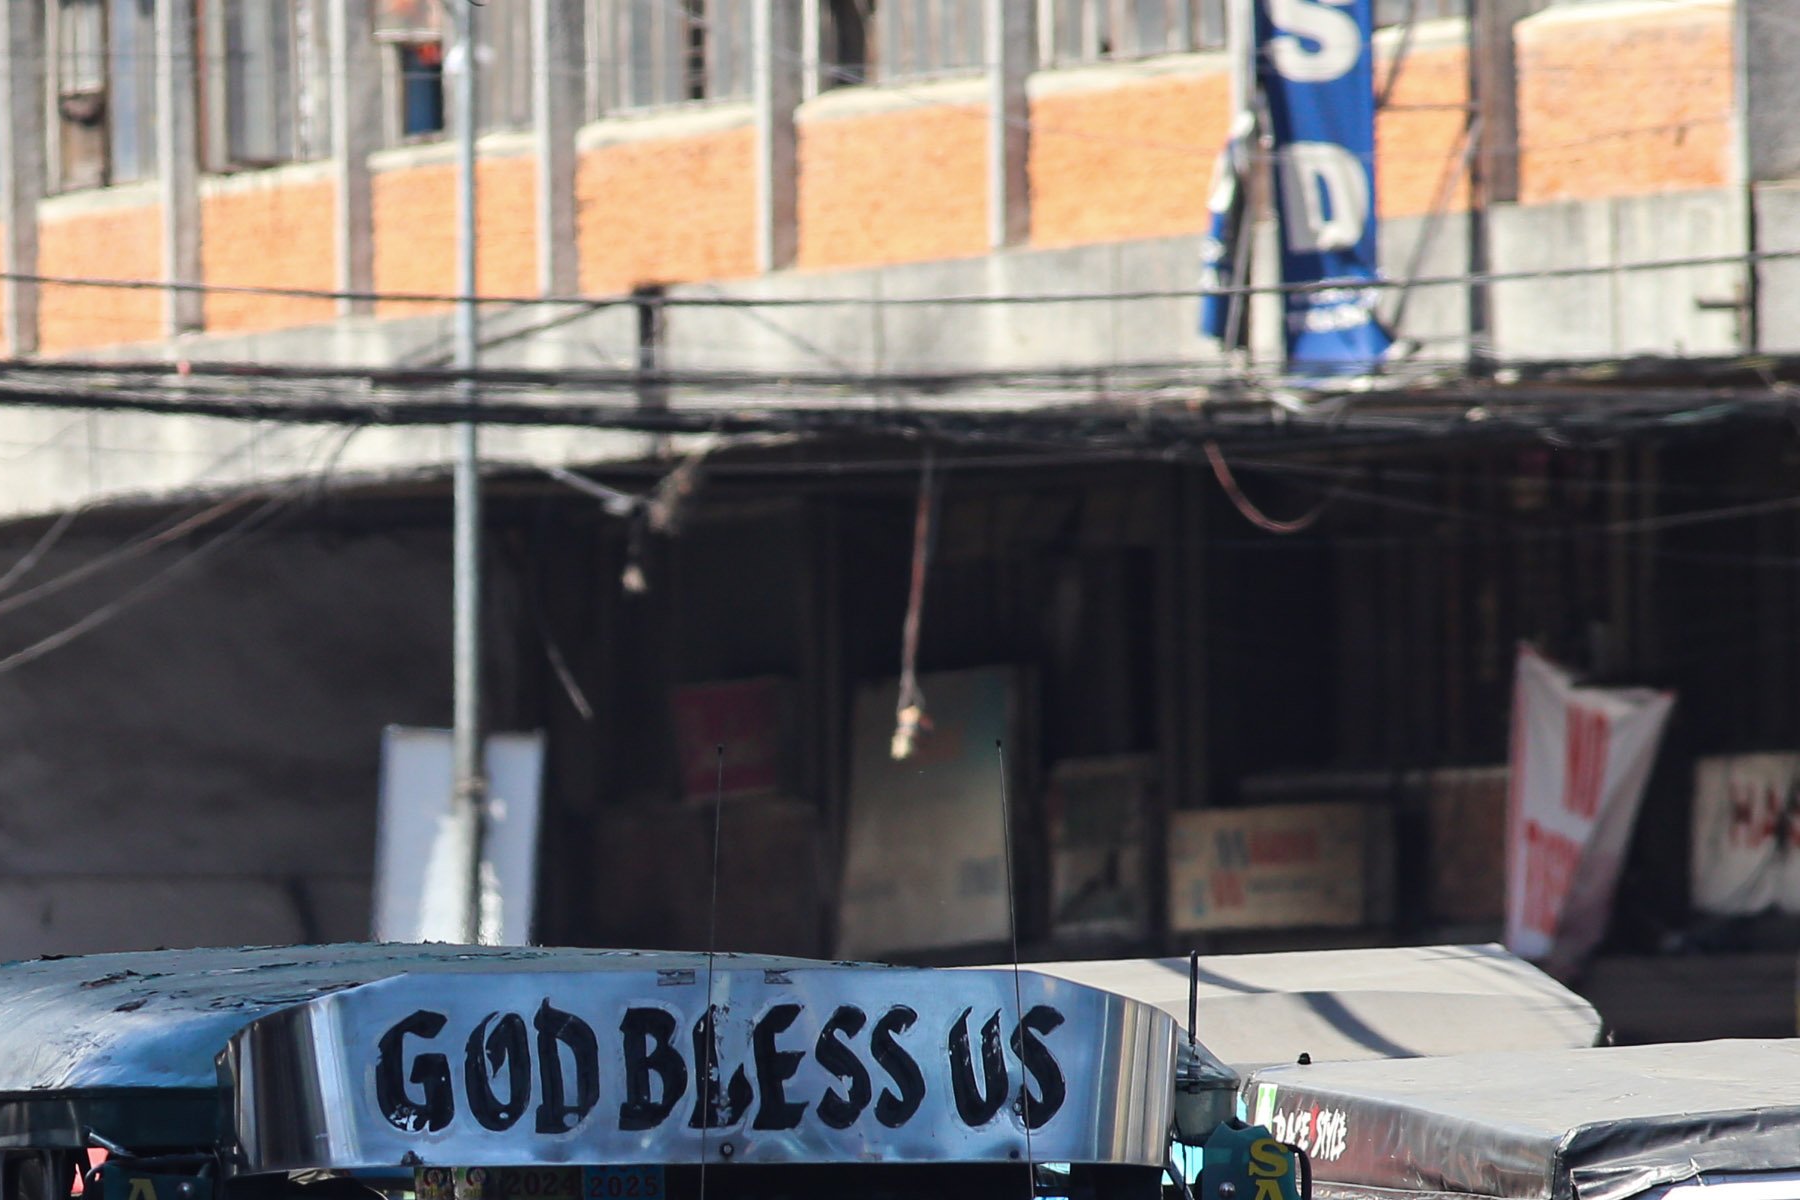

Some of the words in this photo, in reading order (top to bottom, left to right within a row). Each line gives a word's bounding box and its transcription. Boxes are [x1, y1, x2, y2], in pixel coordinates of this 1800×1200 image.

[374, 998, 600, 1134] GOD
[619, 1003, 928, 1132] BLESS
[948, 1003, 1068, 1131] US
[506, 1171, 579, 1196] 2024
[591, 1175, 659, 1197] 2025
